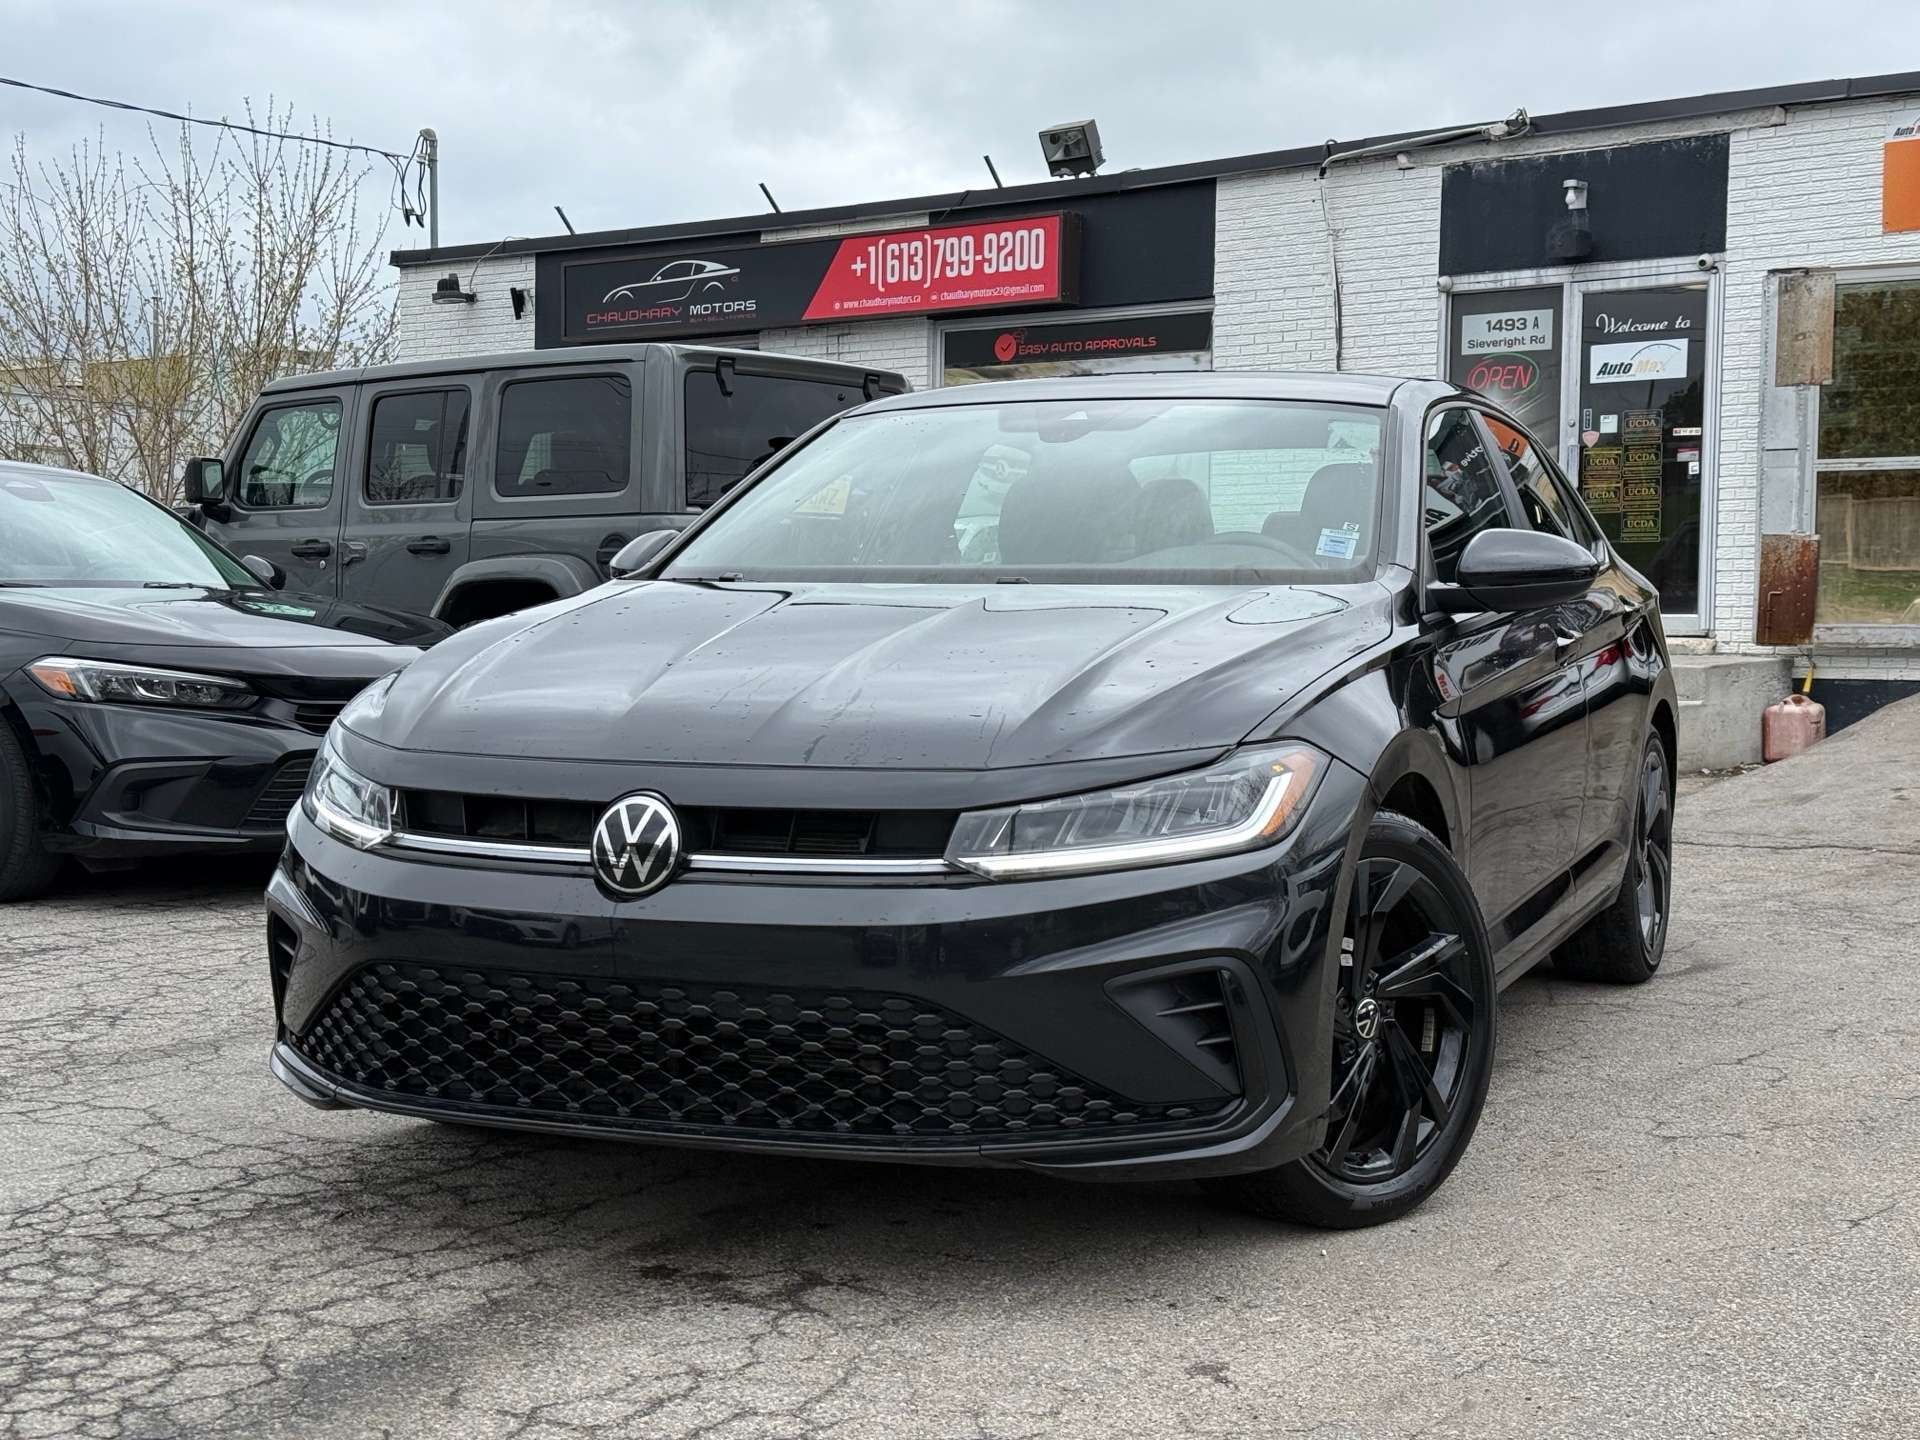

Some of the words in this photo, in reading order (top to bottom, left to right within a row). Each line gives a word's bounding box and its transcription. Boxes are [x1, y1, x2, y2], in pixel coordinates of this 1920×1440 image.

[851, 228, 1045, 292] +1(613)799-9200
[587, 307, 682, 325] CHAUDHARY
[689, 300, 757, 316] MOTORS
[1485, 317, 1527, 333] 1493
[1532, 316, 1540, 330] A
[1595, 313, 1669, 334] Welcome
[1674, 315, 1691, 329] to
[1018, 343, 1050, 355] EASY
[1051, 341, 1082, 353] AUTO
[1085, 336, 1157, 350] APPROVALS
[1467, 335, 1527, 350] Sieveright
[1529, 334, 1546, 345] Rd
[1596, 361, 1633, 376] Auto
[1470, 364, 1533, 390] OPEN
[1629, 419, 1656, 428] UCDA
[1589, 457, 1616, 466] UCDA
[1629, 452, 1656, 461] UCDA
[1628, 487, 1656, 496] UCDA
[1627, 519, 1654, 528] UCDA
